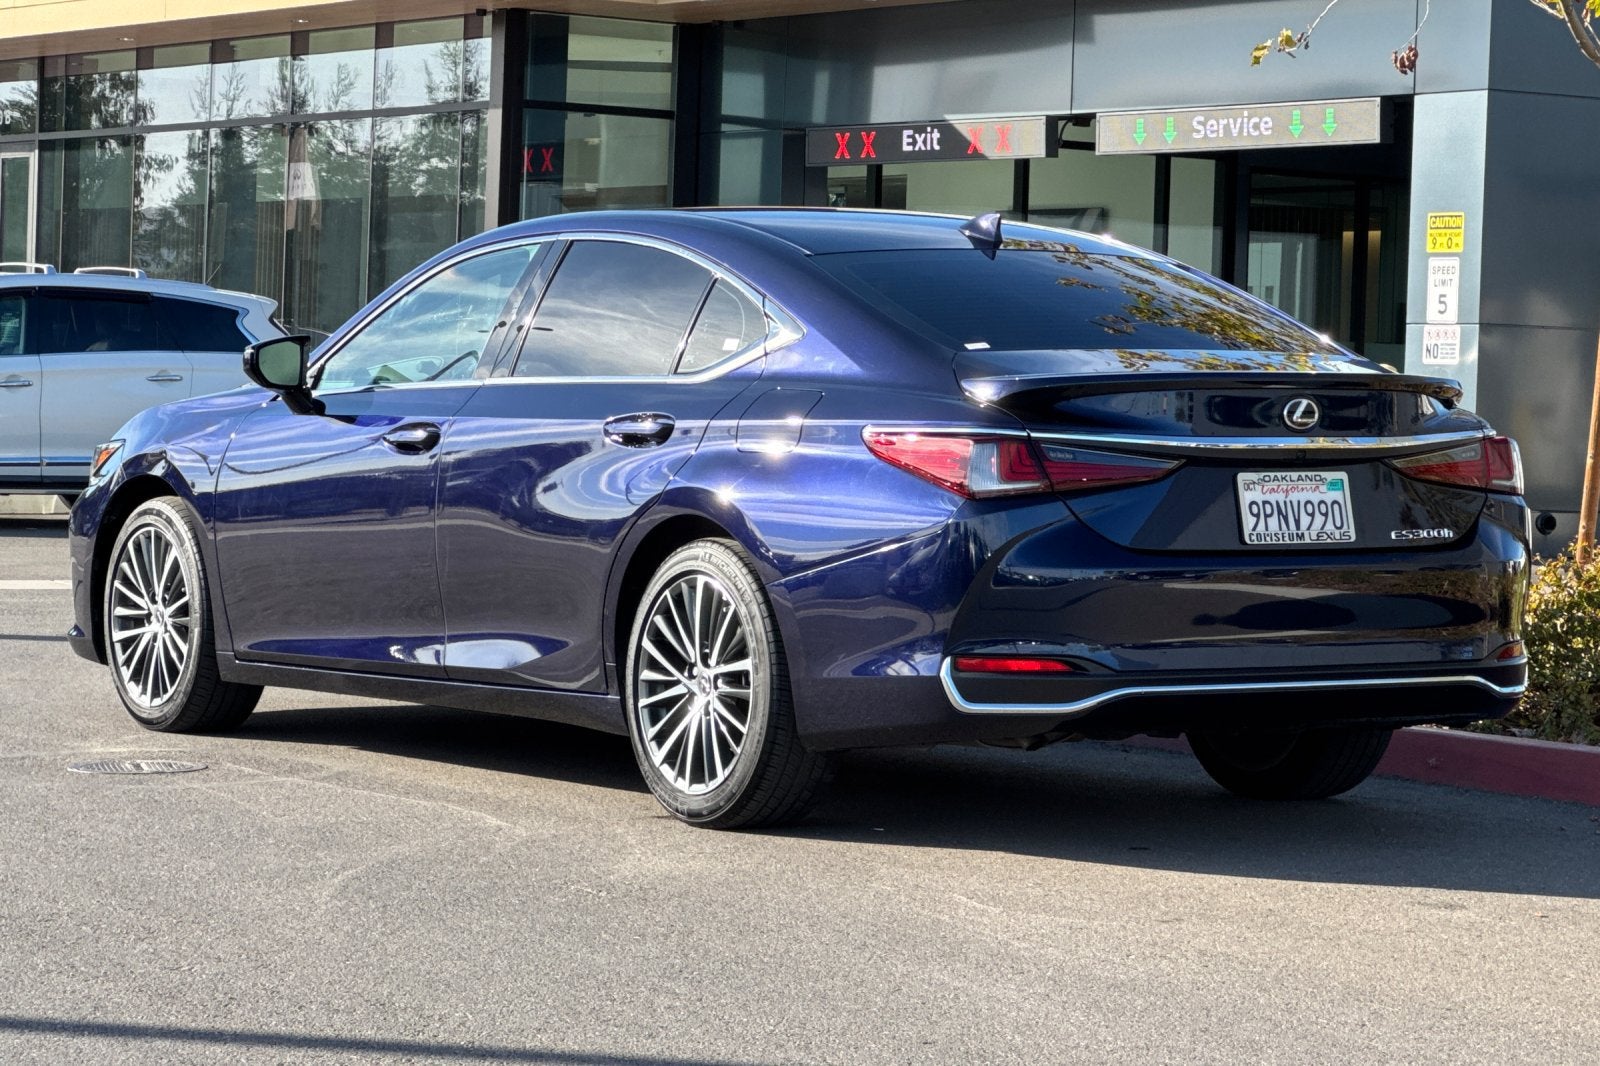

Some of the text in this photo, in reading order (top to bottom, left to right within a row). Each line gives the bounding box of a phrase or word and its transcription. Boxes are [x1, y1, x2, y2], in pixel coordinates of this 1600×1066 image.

[1192, 110, 1273, 139] Service
[902, 127, 940, 151] Exit
[1430, 216, 1462, 228] CAUTION
[1431, 237, 1437, 249] 9
[1446, 237, 1453, 249] 0
[1432, 265, 1456, 275] SPEED
[1434, 278, 1453, 287] LIMIT
[1437, 294, 1448, 314] 5
[1425, 343, 1439, 359] NO
[1262, 474, 1322, 483] OAKLAND
[1243, 482, 1256, 491] OCT
[1261, 484, 1327, 498] California
[1248, 499, 1344, 531] 9PNV990
[1248, 531, 1351, 542] COLISEUM LEXUS
[1391, 528, 1453, 540] ES300h
